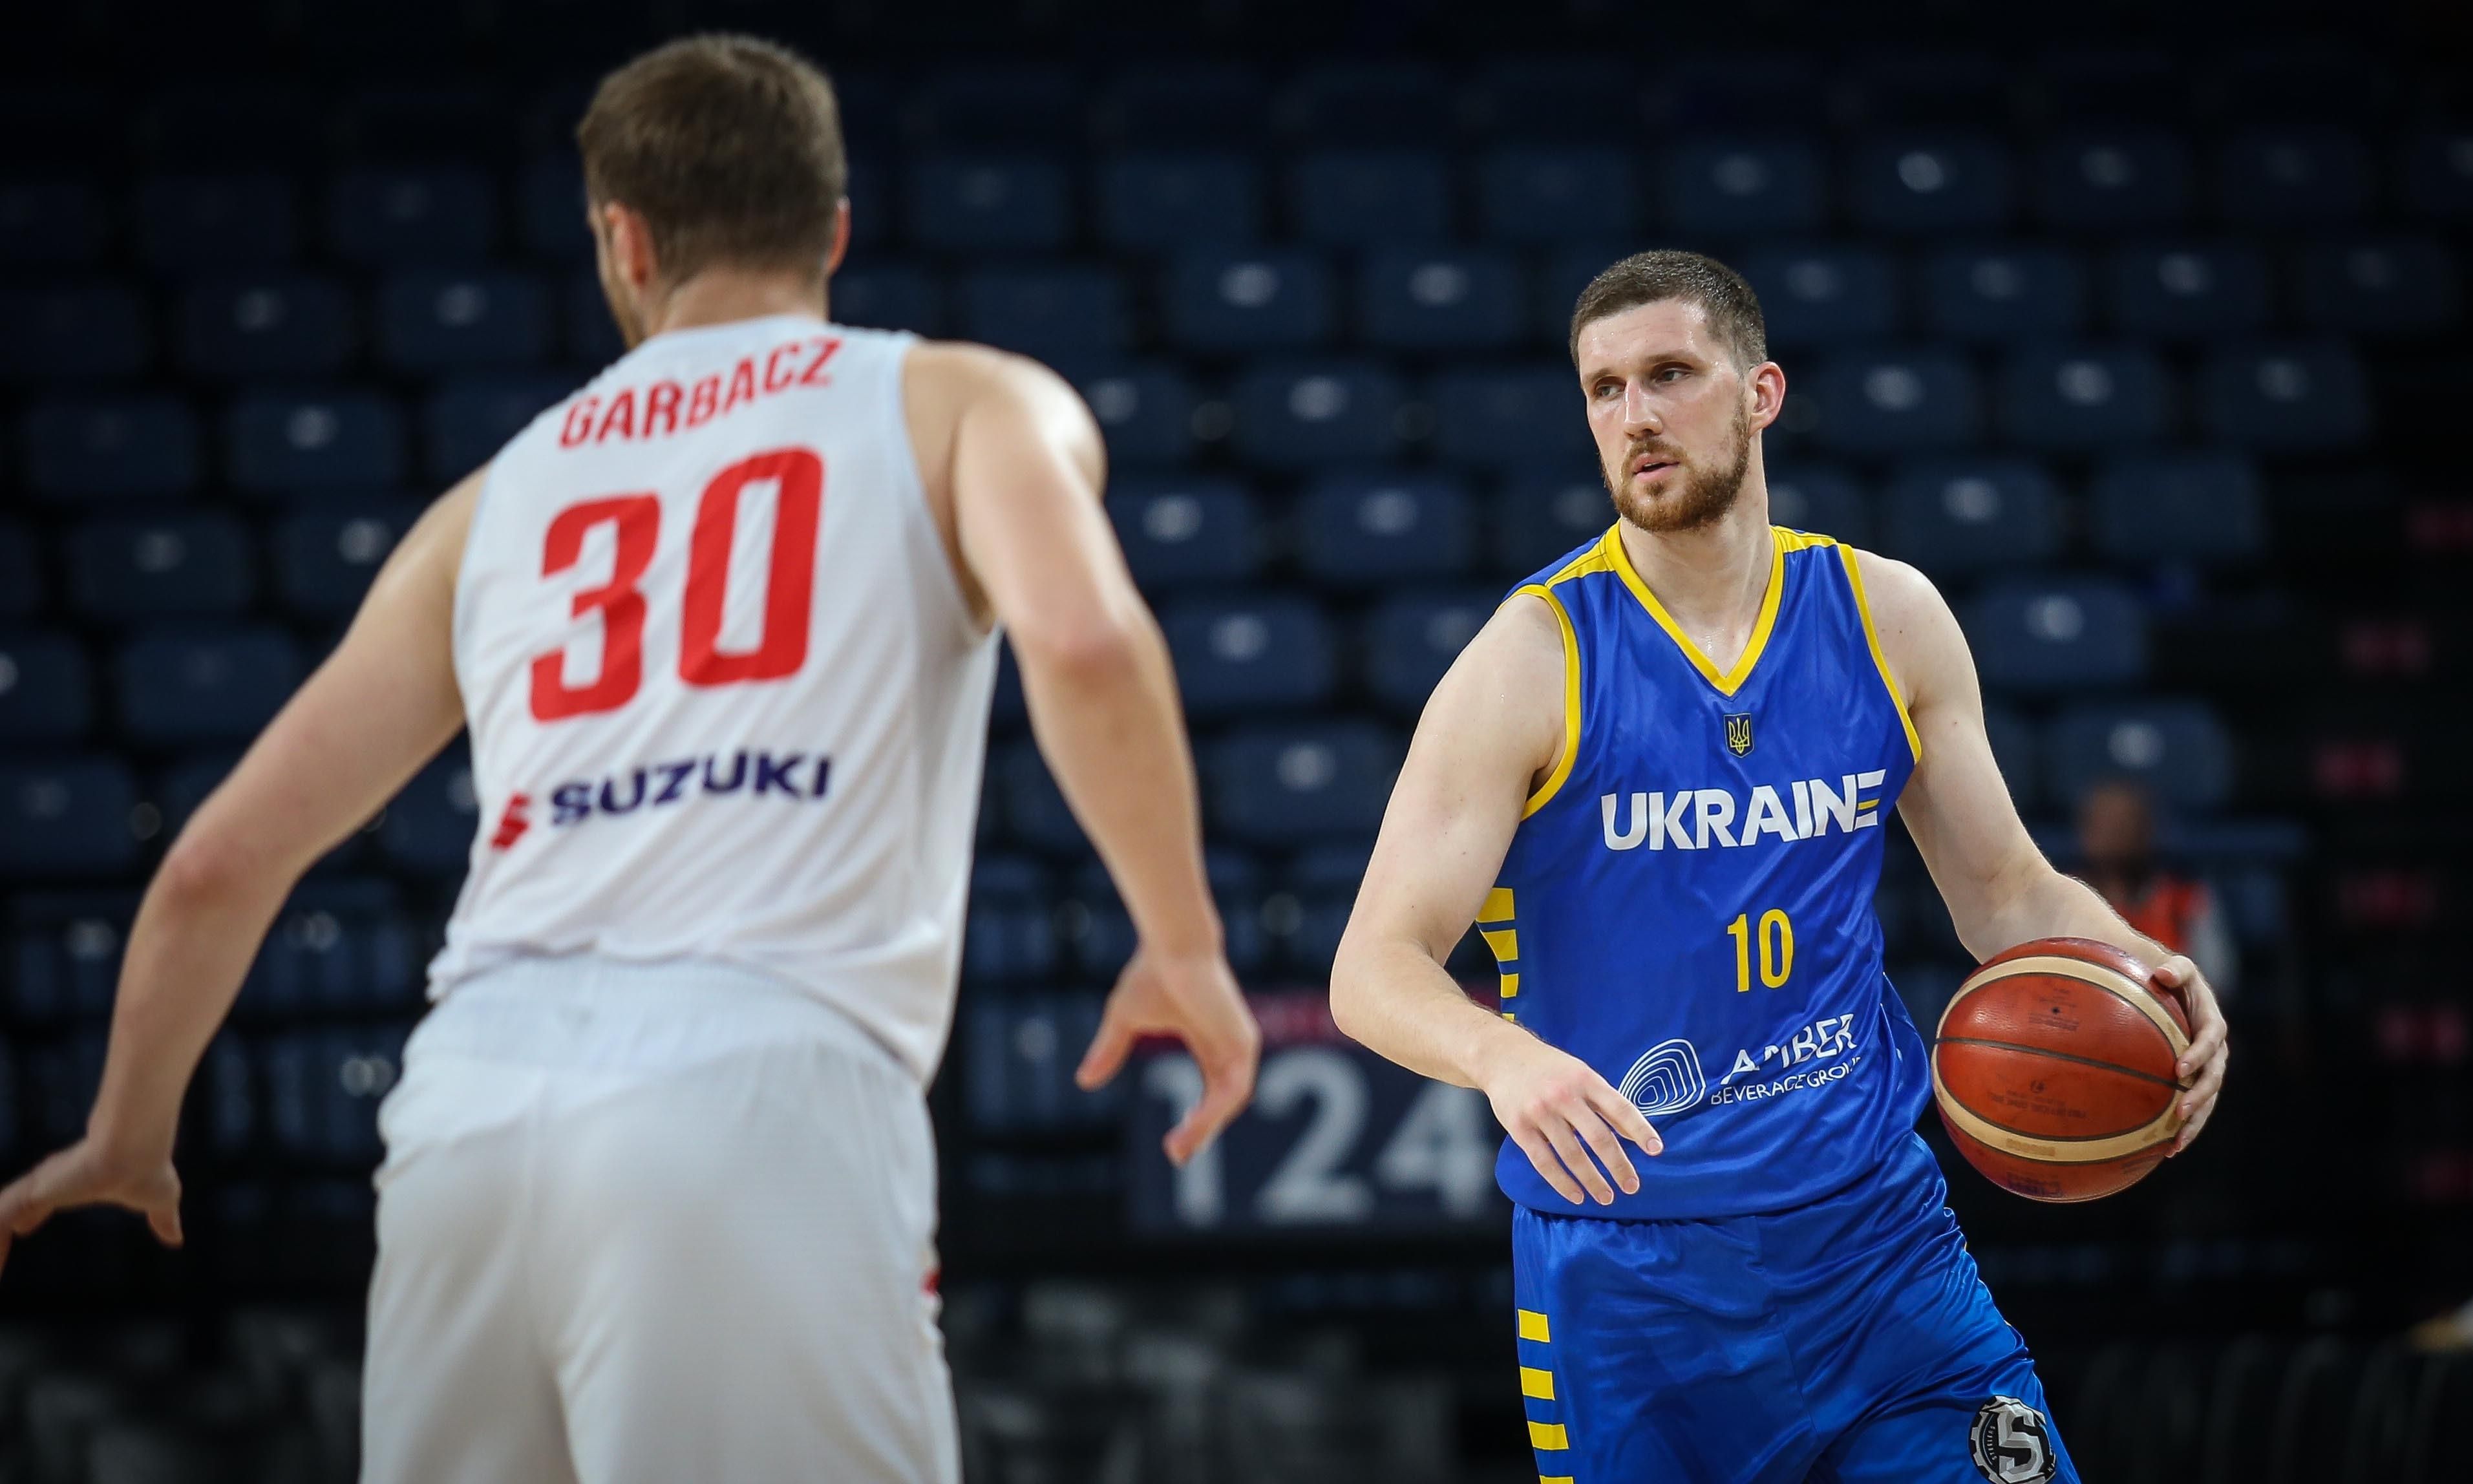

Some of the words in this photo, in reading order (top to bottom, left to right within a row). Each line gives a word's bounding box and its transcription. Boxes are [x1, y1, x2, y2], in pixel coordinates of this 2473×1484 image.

[560, 339, 842, 447] GARBACZ
[530, 446, 824, 723] 30
[551, 751, 833, 825] SUZUKI
[1601, 769, 1886, 850] UKRAINE
[1728, 909, 1793, 991] 10
[1145, 1048, 1489, 1223] 124
